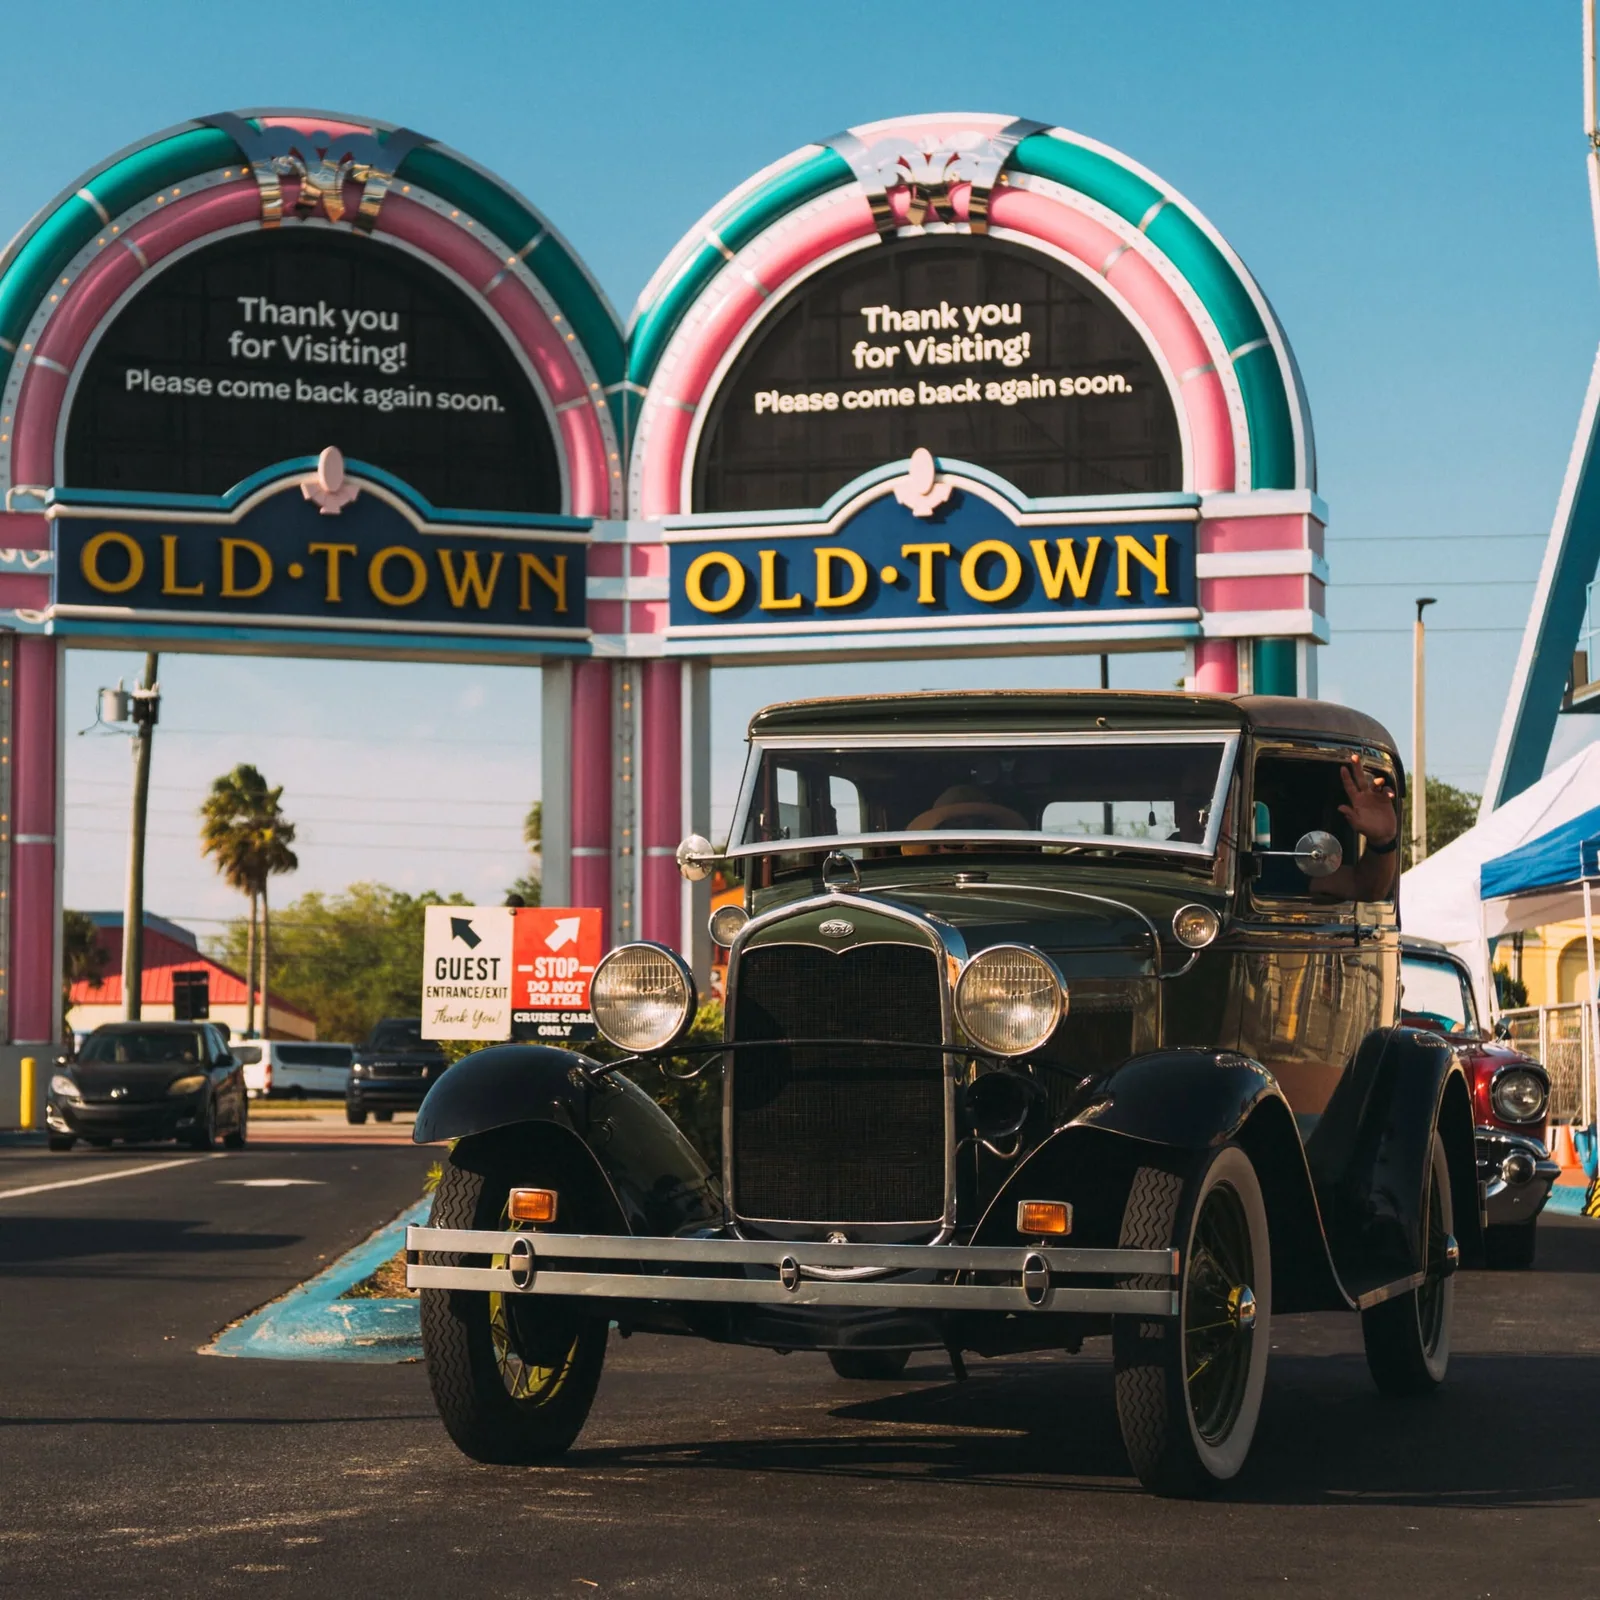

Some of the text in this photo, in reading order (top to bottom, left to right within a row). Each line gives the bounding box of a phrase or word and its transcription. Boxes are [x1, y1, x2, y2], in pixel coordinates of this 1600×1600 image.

[238, 296, 400, 337] Thank you
[860, 301, 1023, 334] Thank you
[228, 330, 408, 374] for Visiting!
[851, 332, 1031, 370] for Visiting!
[125, 368, 506, 412] Please come back again soon.
[754, 373, 1134, 415] Please come back again soon.
[81, 531, 568, 613] OLD TOWN
[684, 533, 1170, 614] OLD TOWN
[435, 957, 501, 981] GUEST
[426, 986, 508, 999] ENTRANCE/EXIT
[527, 981, 586, 993] DO NOT
[529, 993, 582, 1006] ENTER
[431, 1005, 502, 1030] Thank You!
[513, 1012, 558, 1024] CRUISE
[537, 1025, 573, 1037] ONLY
